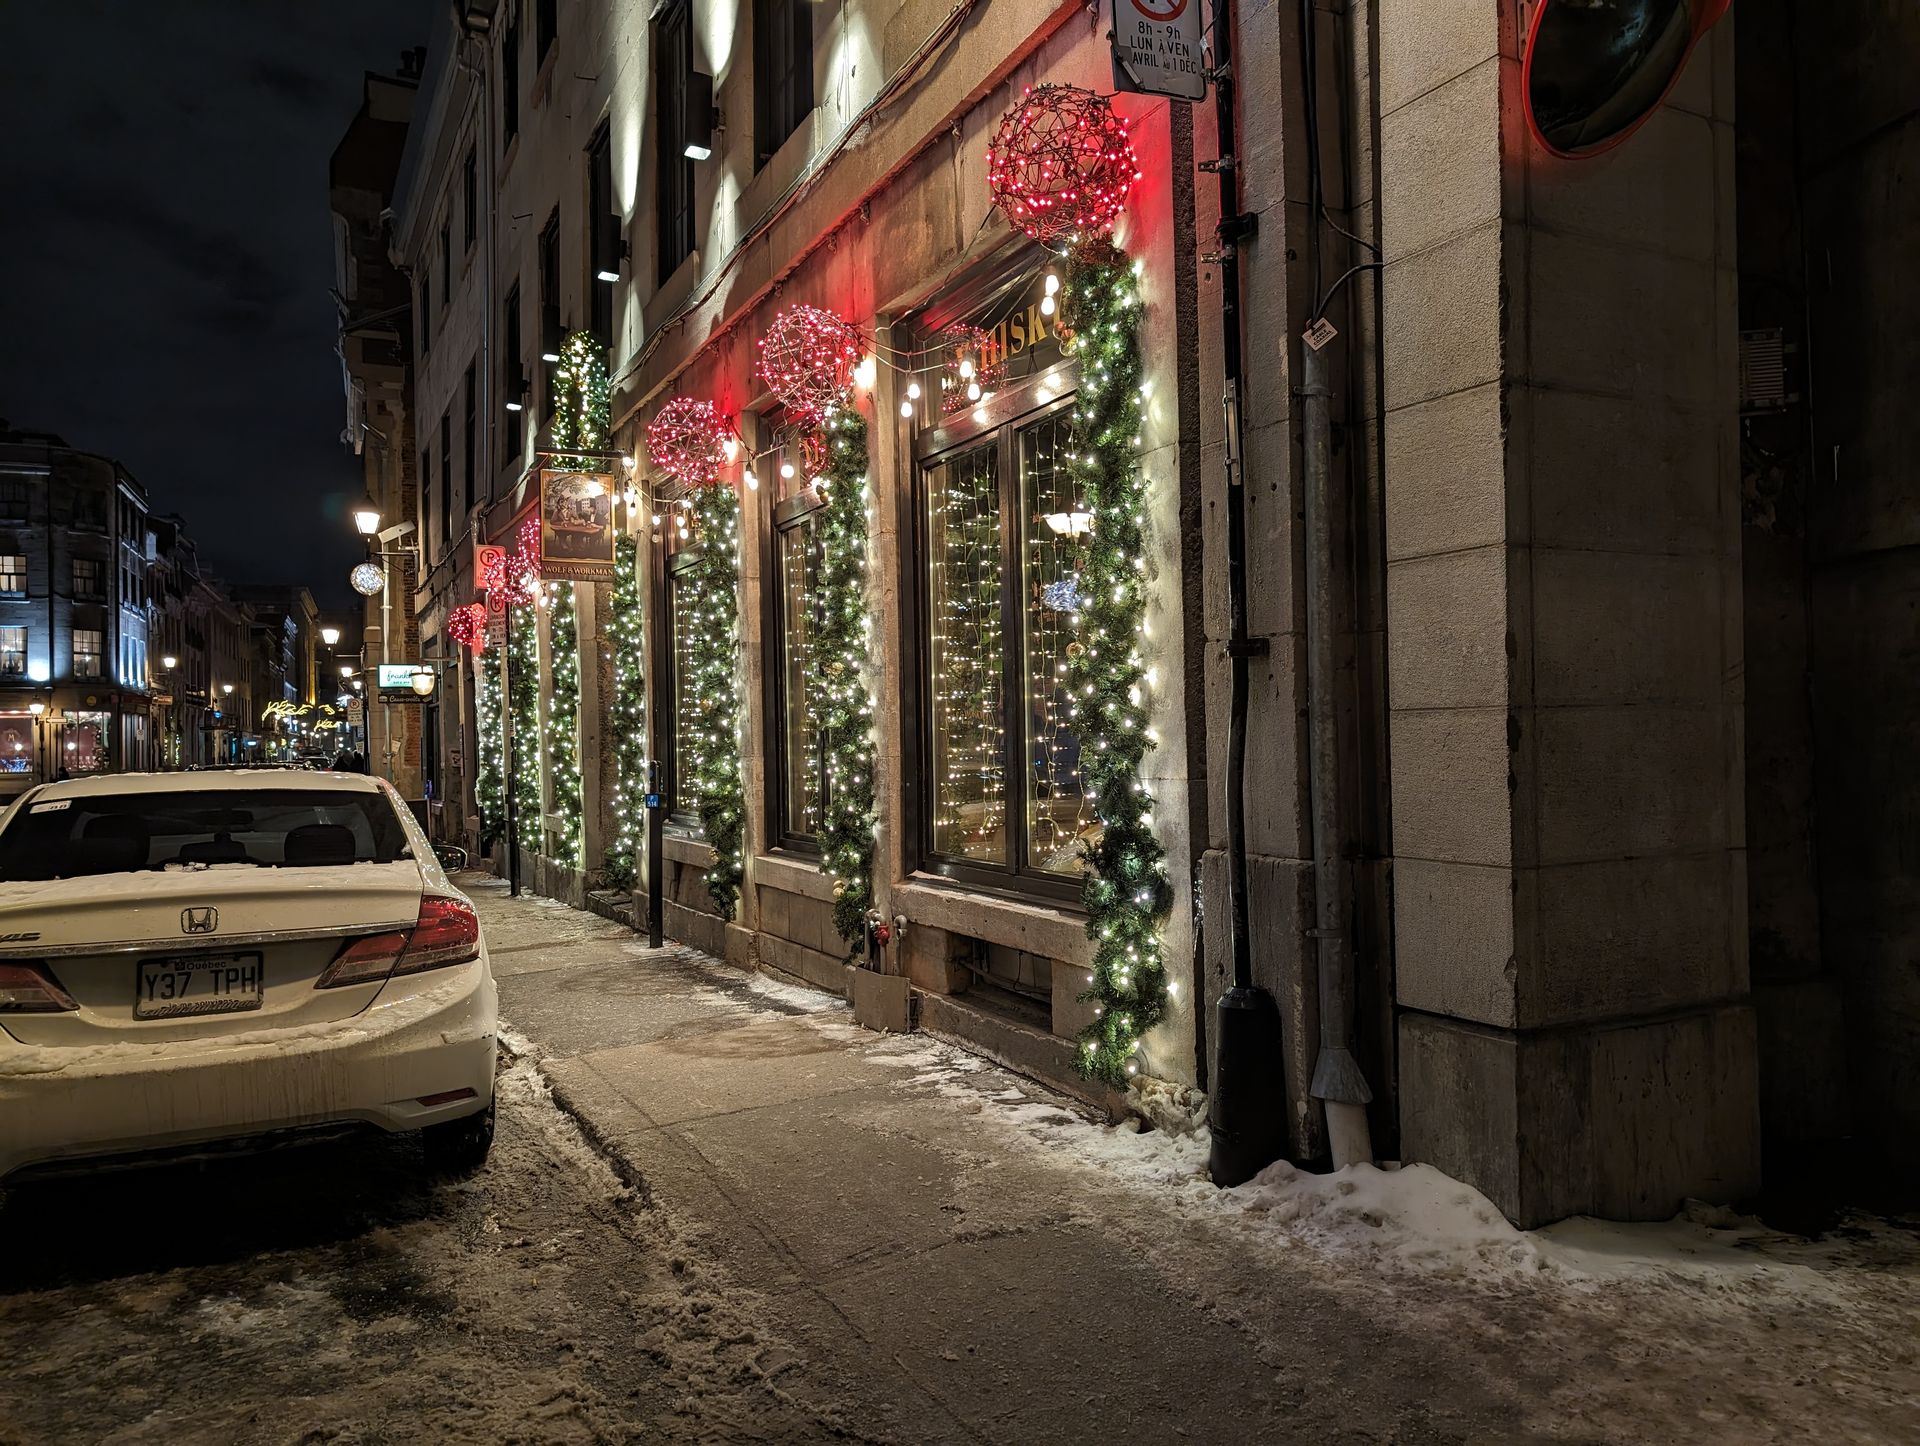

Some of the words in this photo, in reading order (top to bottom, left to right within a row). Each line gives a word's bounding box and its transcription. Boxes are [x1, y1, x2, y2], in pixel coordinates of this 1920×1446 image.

[1138, 21, 1152, 35] 8h
[1166, 25, 1180, 40] 9h
[1130, 35, 1153, 51] LUN
[1159, 39, 1165, 55] À
[1167, 41, 1190, 58] VEN
[1132, 51, 1159, 68] AVRIL
[1173, 57, 1177, 71] 1
[1180, 57, 1197, 74] DÉC
[186, 961, 227, 971] Québec
[145, 972, 192, 1001] Y37
[210, 966, 256, 995] TPH
